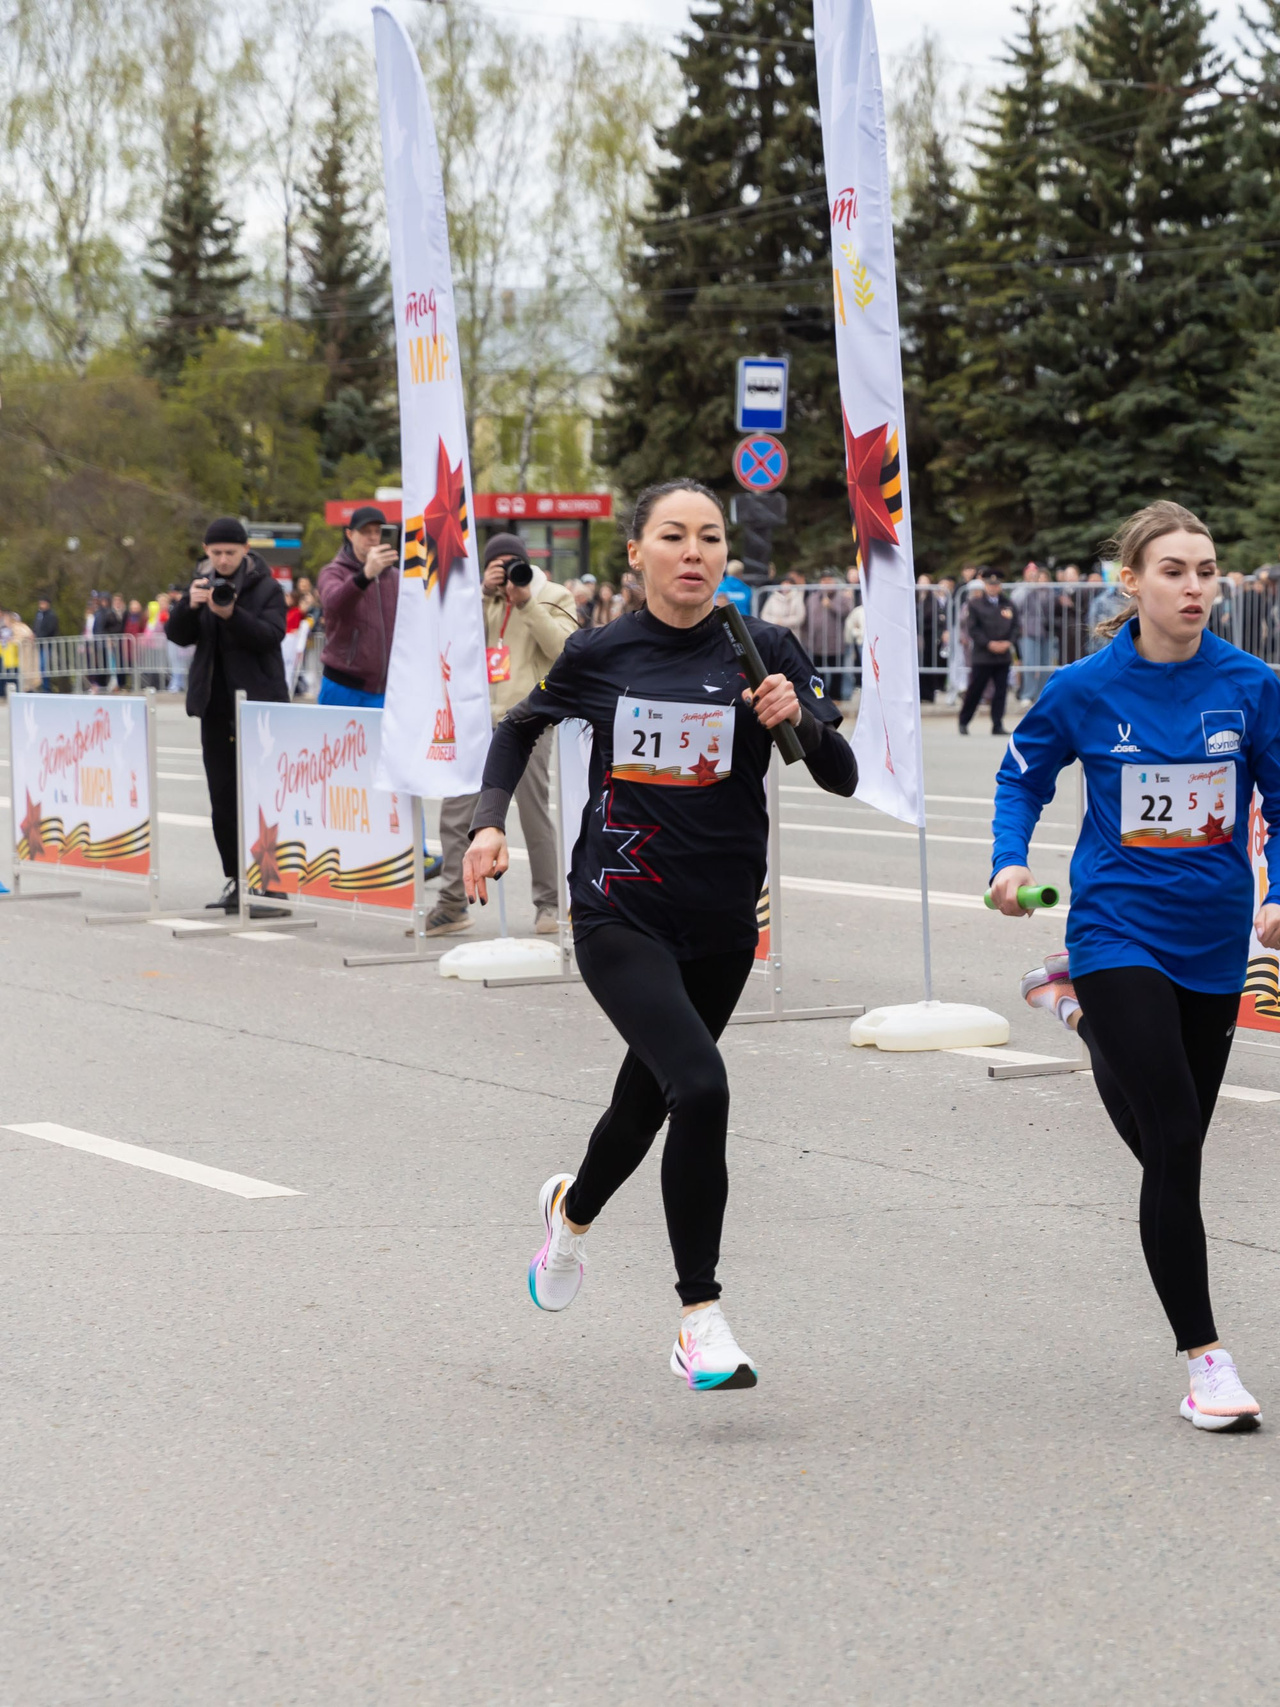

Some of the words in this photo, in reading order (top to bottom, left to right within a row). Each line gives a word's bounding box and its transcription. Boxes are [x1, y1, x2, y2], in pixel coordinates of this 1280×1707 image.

[631, 730, 662, 758] 21
[679, 731, 690, 749] 5
[1110, 744, 1141, 753] JÖGEL
[81, 766, 114, 808] МИРА
[276, 719, 367, 829] Эстафета
[329, 785, 371, 834] МИРА
[1140, 795, 1173, 822] 22
[1188, 792, 1198, 810] 5
